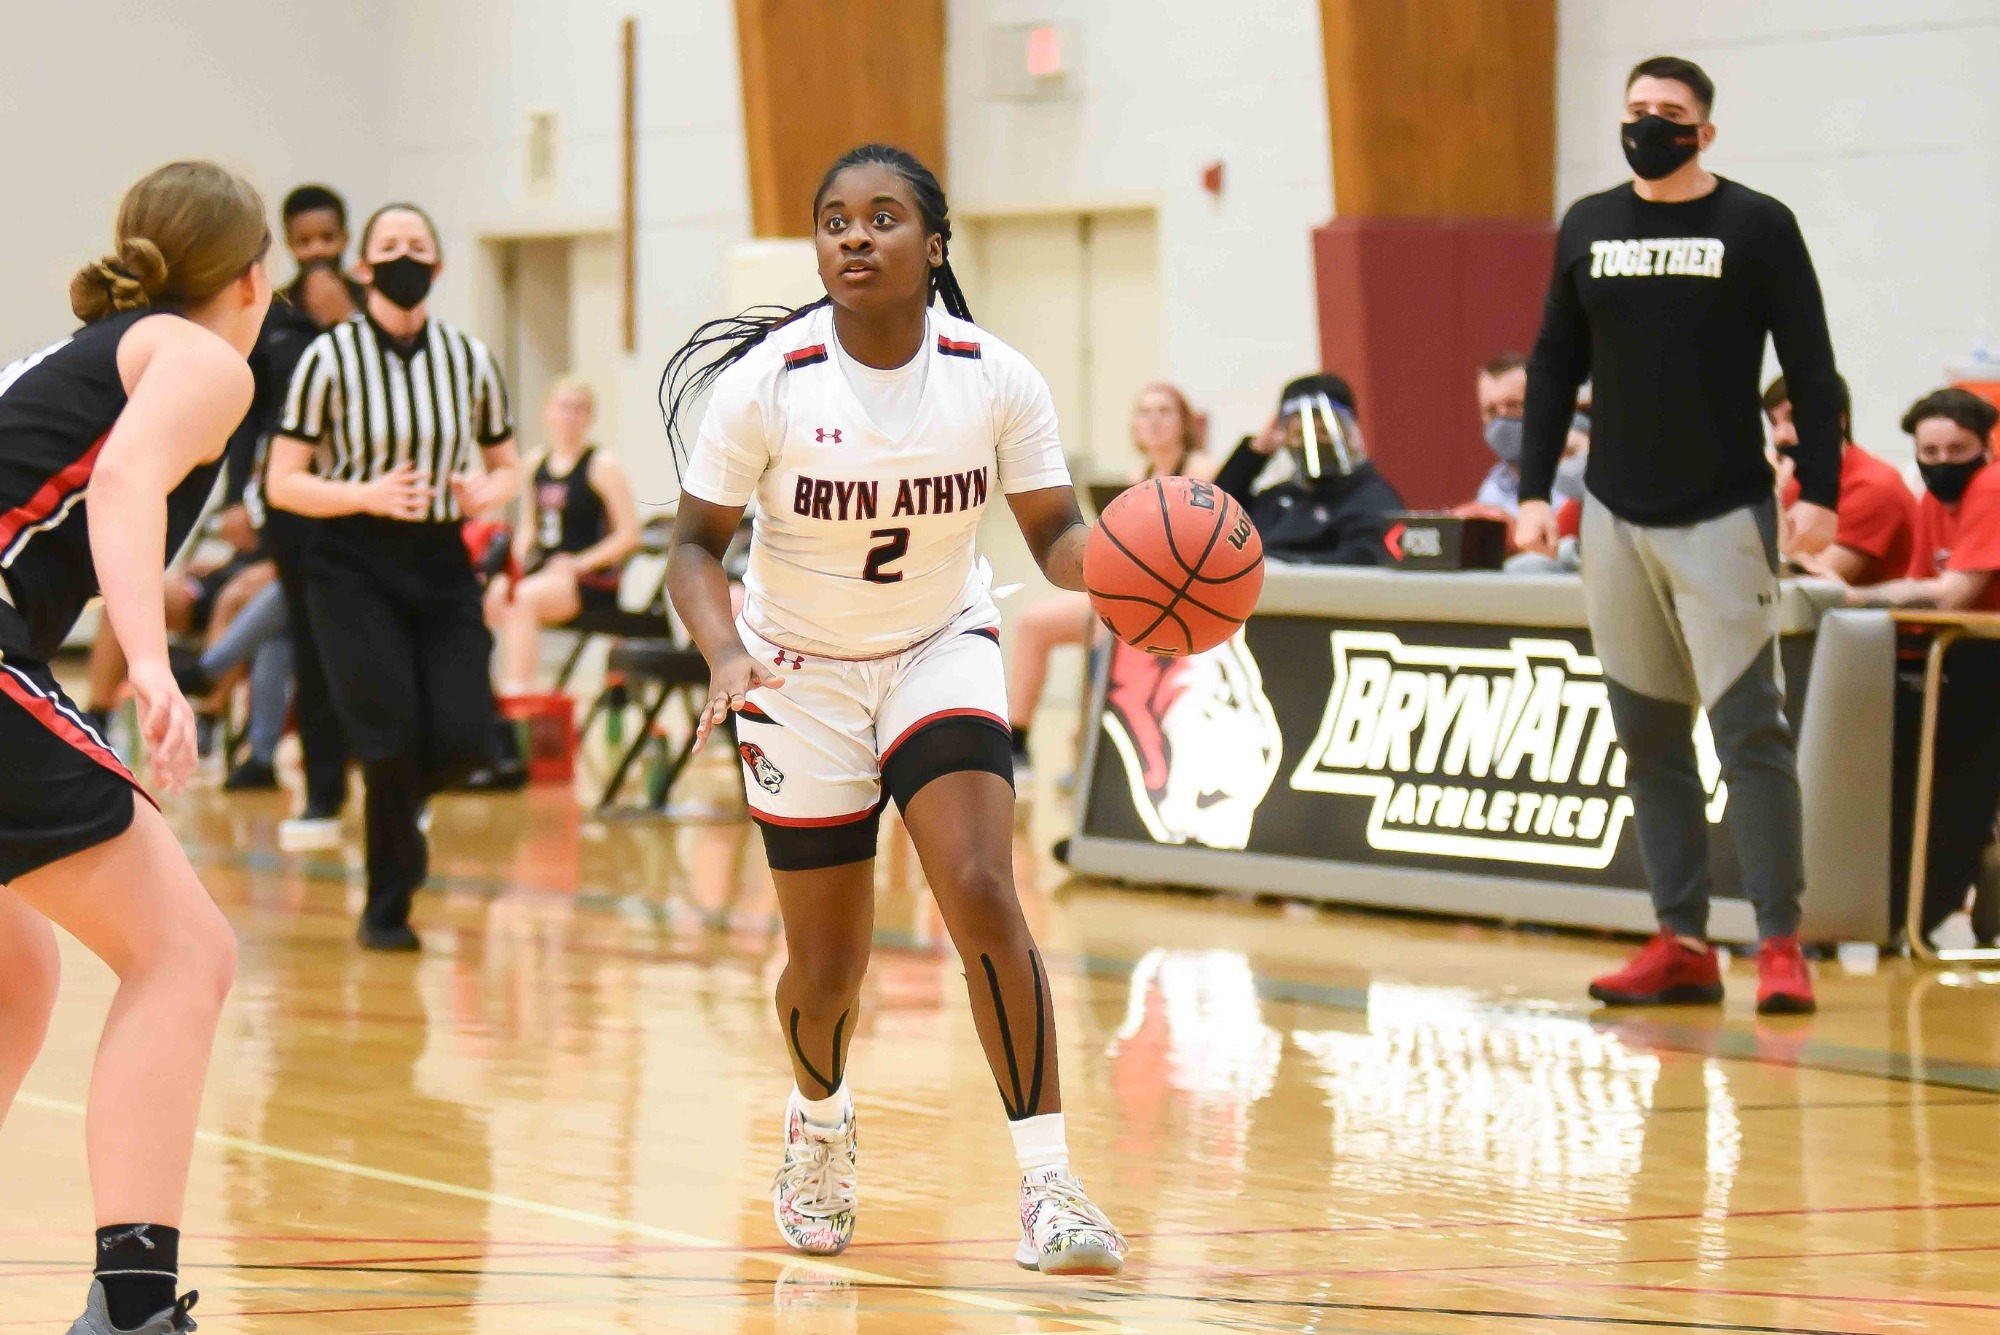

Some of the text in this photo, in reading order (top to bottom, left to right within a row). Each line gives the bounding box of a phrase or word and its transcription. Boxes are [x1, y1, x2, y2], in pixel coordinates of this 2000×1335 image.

[1590, 237, 1725, 278] TOGETHER
[793, 465, 988, 521] BRYN ATHYN
[862, 527, 911, 584] 2
[1320, 656, 1514, 778] BRYN
[1385, 783, 1609, 840] ATHLETICS
